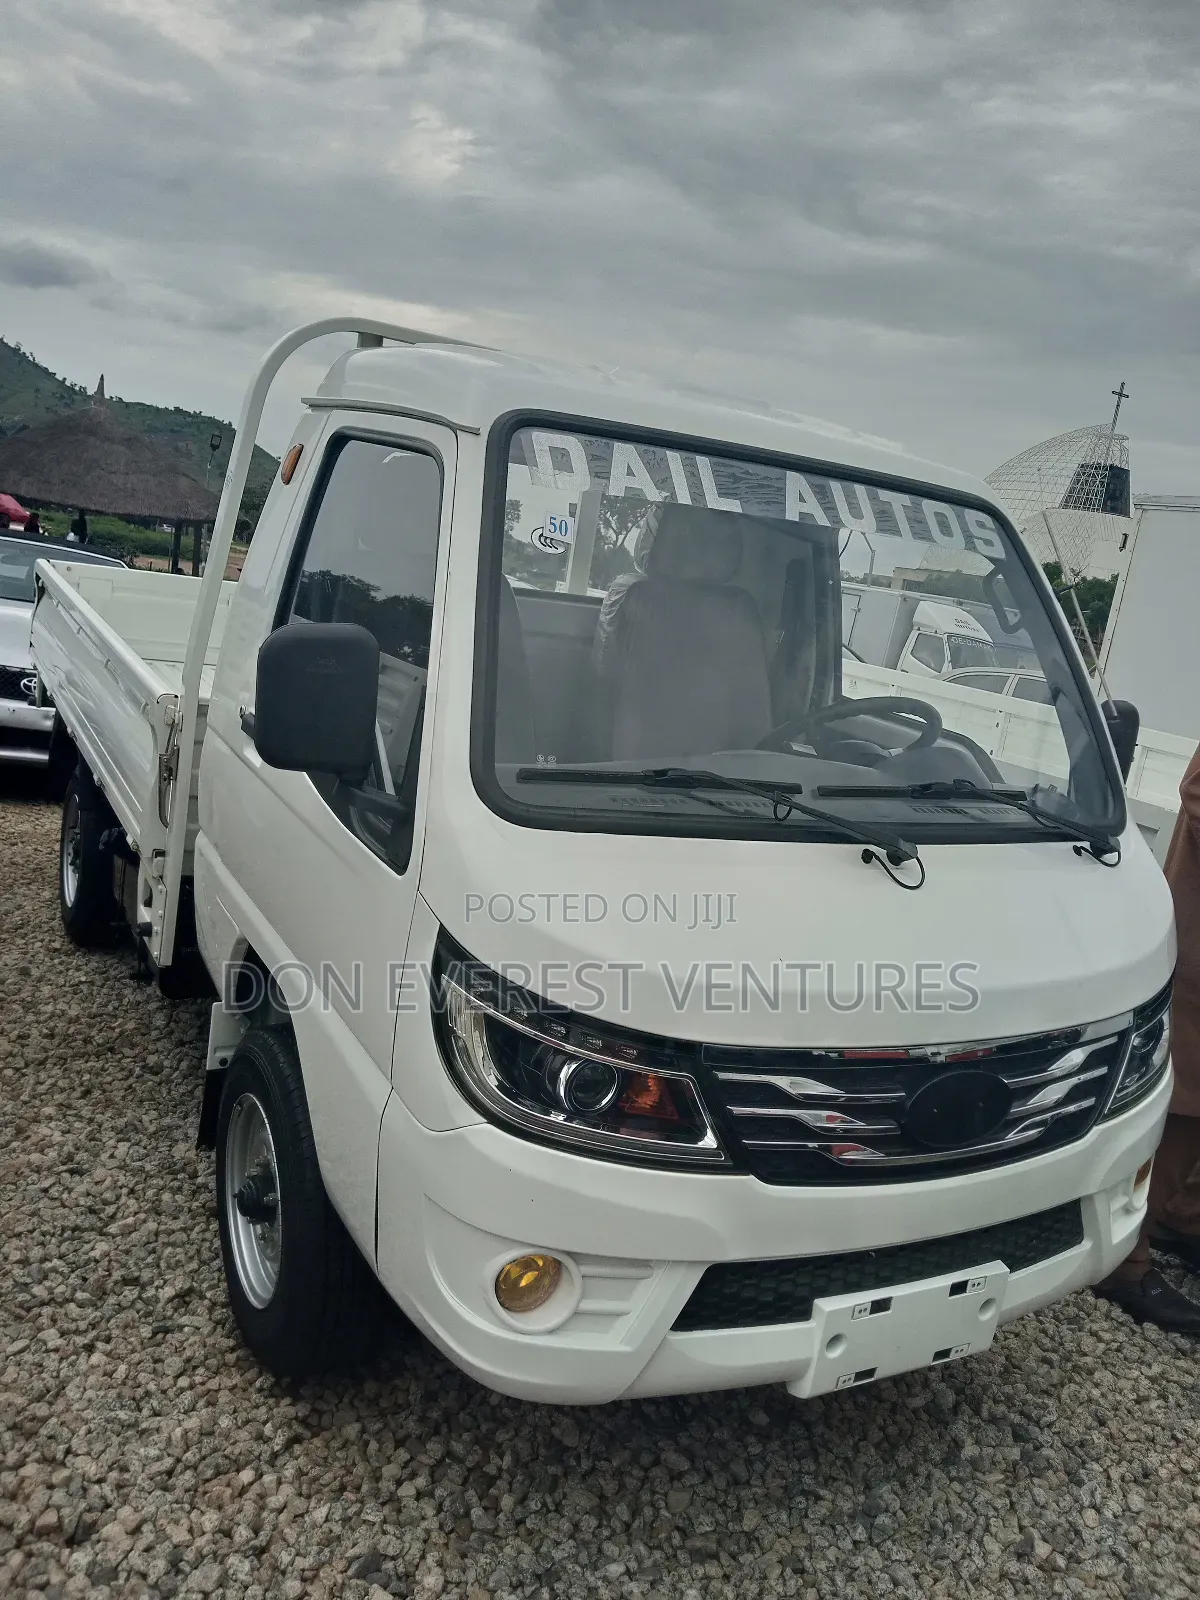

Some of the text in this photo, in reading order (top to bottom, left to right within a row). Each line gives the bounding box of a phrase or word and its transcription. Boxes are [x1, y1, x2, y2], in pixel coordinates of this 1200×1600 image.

[531, 431, 1006, 559] DAIL AUTOS
[548, 516, 568, 537] 50
